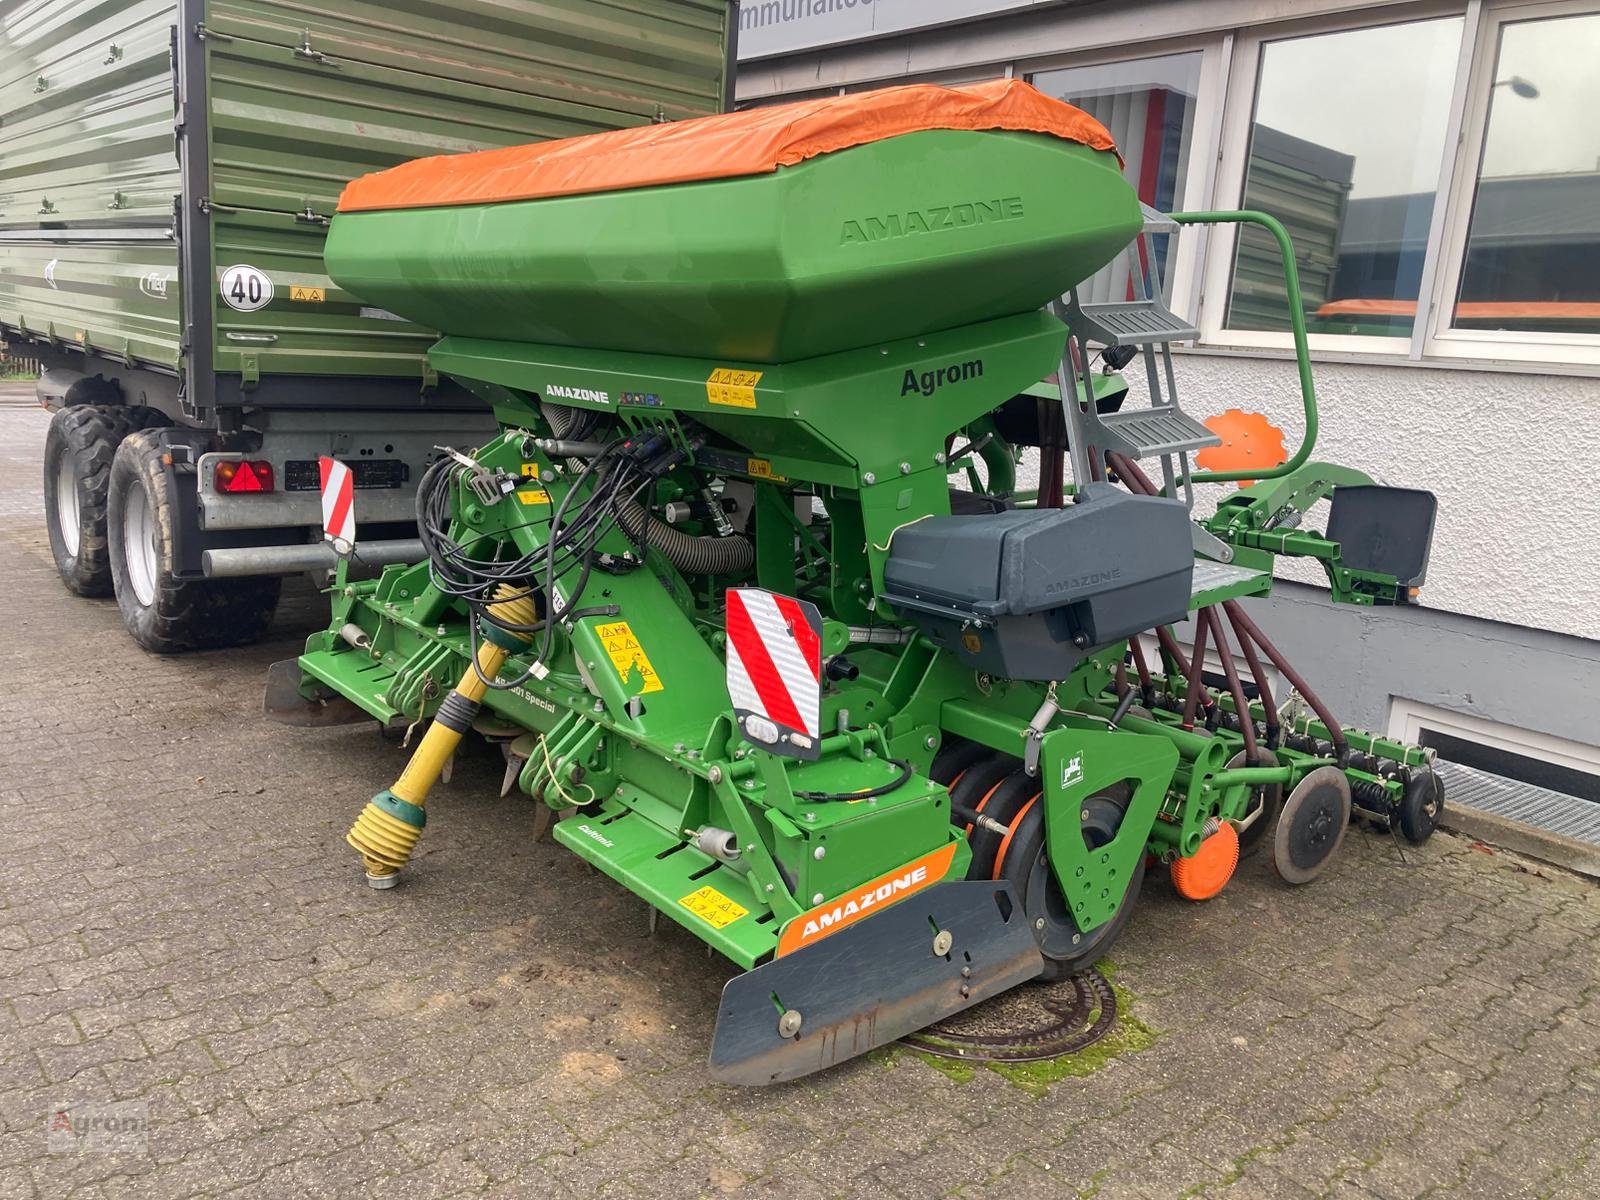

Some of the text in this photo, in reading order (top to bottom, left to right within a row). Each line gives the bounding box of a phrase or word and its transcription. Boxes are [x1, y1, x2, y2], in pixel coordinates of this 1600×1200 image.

[840, 196, 1024, 247] AMAZONE
[230, 273, 263, 304] 40
[900, 359, 984, 397] Agrom
[546, 384, 610, 405] AMAZONE
[1045, 568, 1121, 595] AMAZONE
[525, 691, 556, 714] Special
[802, 866, 927, 940] AMAZONE
